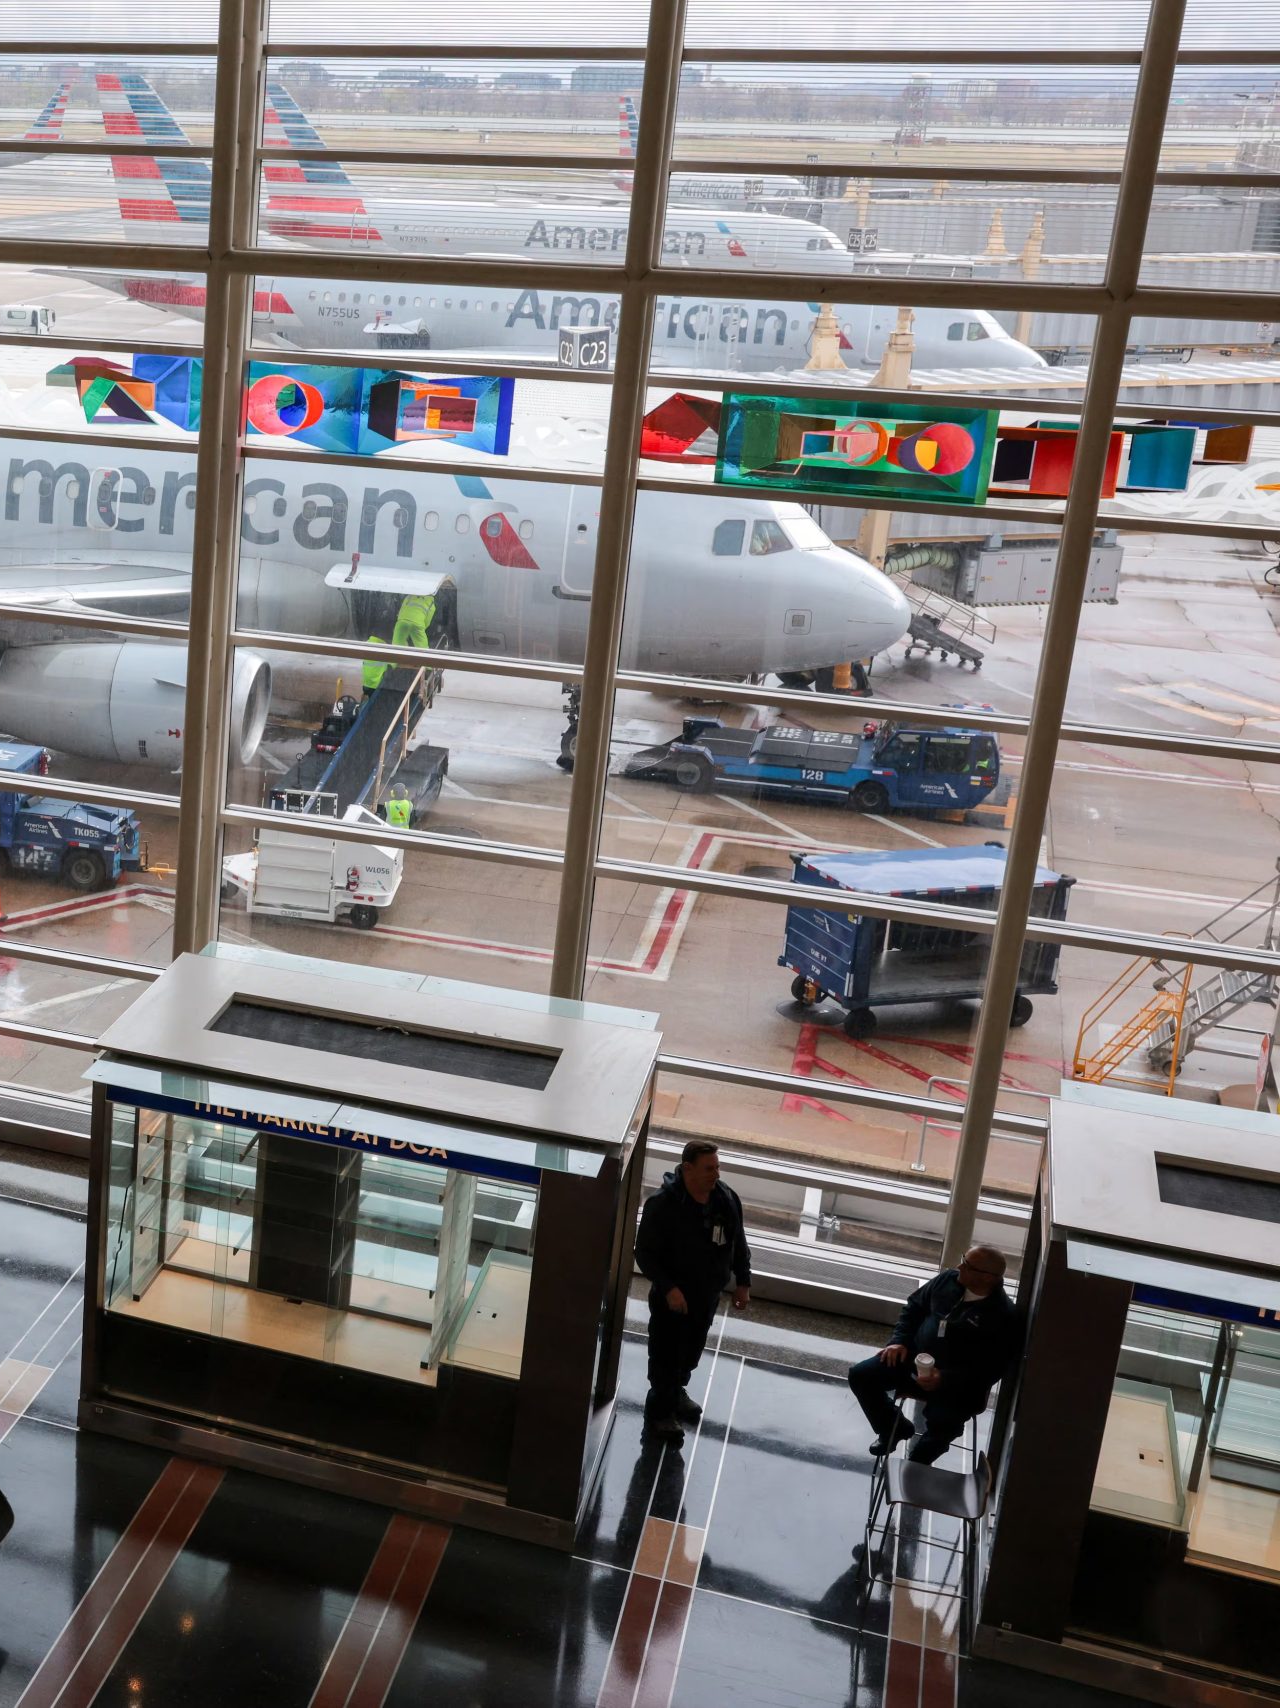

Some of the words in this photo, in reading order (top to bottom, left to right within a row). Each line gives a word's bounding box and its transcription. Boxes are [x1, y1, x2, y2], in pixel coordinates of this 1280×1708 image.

[318, 306, 360, 319] N755US
[560, 340, 574, 367] C23
[580, 340, 607, 366] C23
[801, 769, 824, 781] 128
[24, 821, 49, 830] American
[28, 827, 48, 835] Airlines
